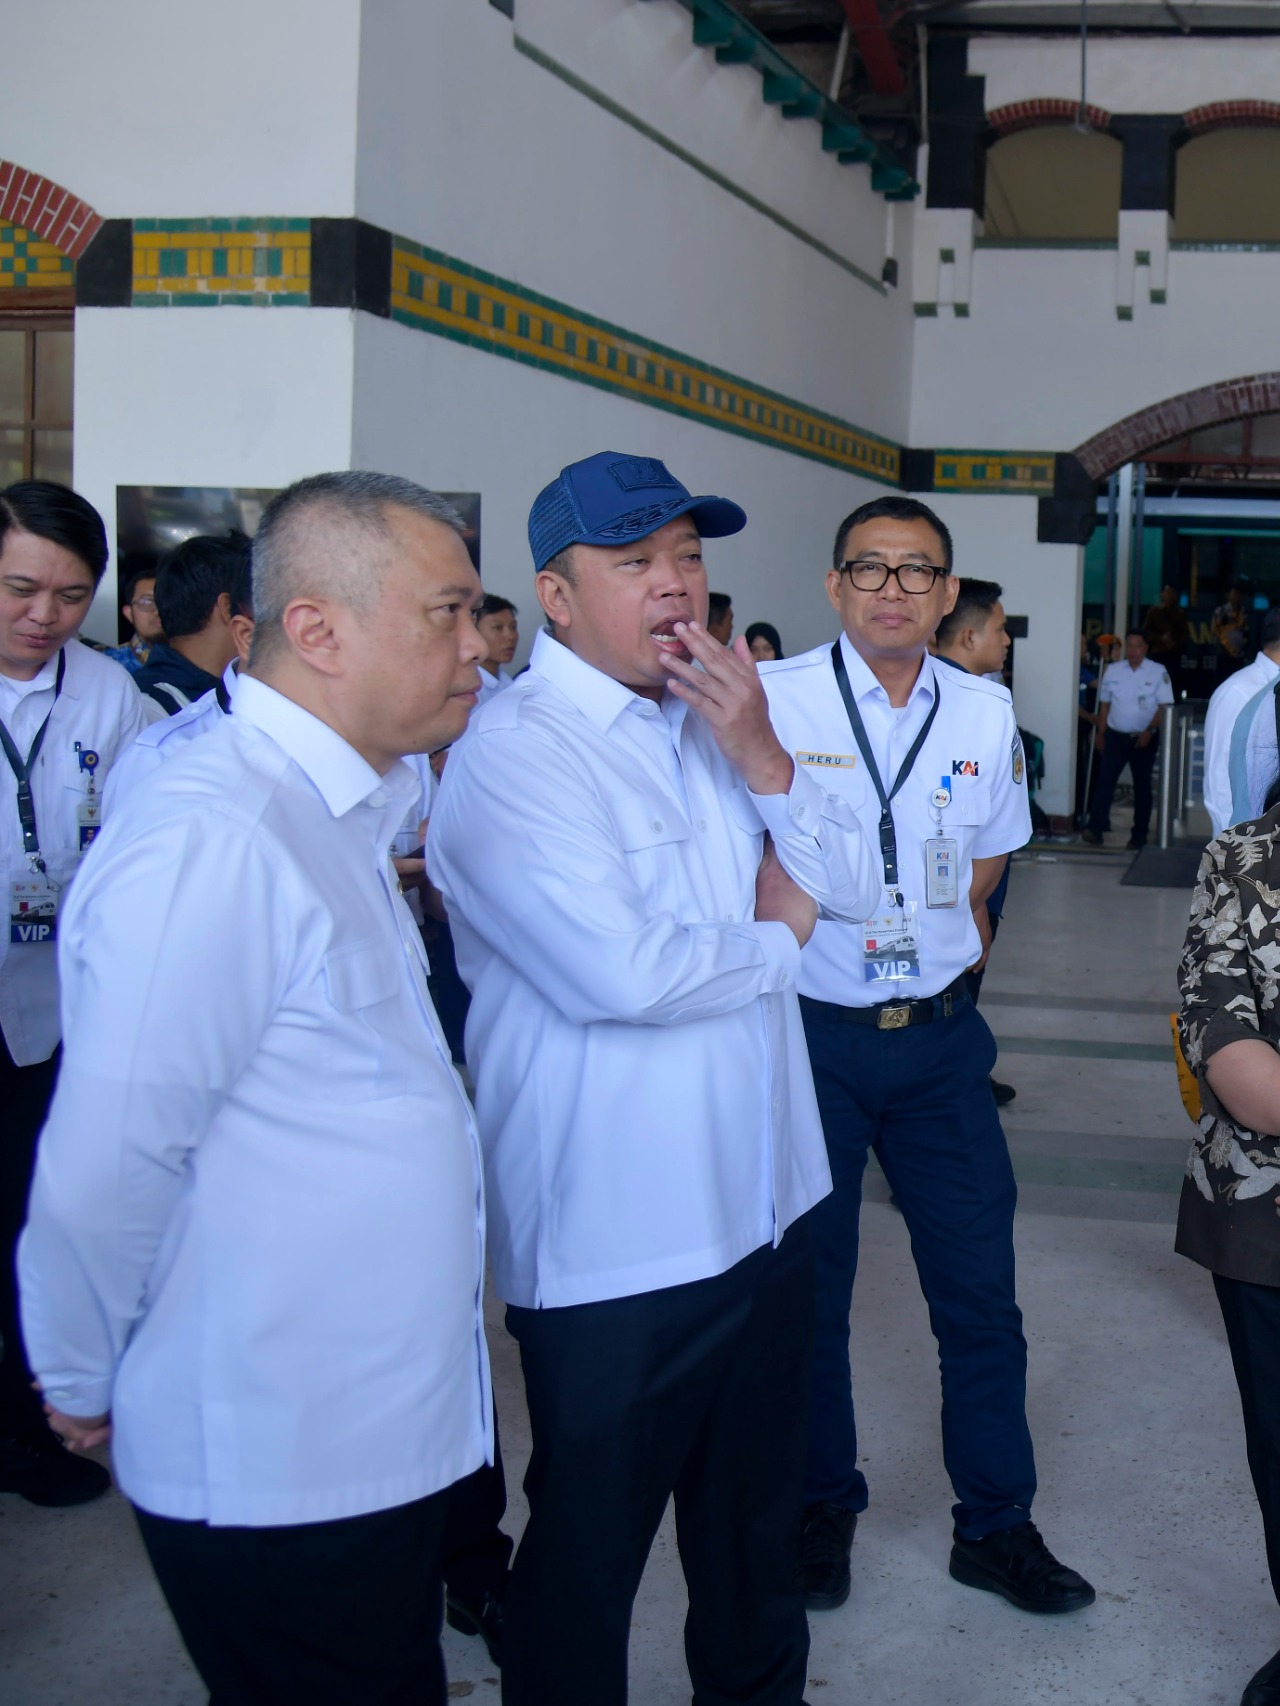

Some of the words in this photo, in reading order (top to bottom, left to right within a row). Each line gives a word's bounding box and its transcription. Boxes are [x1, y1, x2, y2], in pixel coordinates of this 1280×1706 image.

[808, 754, 841, 765] HERU
[952, 760, 979, 776] KAI
[18, 924, 50, 942] VIP
[873, 961, 911, 979] VIP
